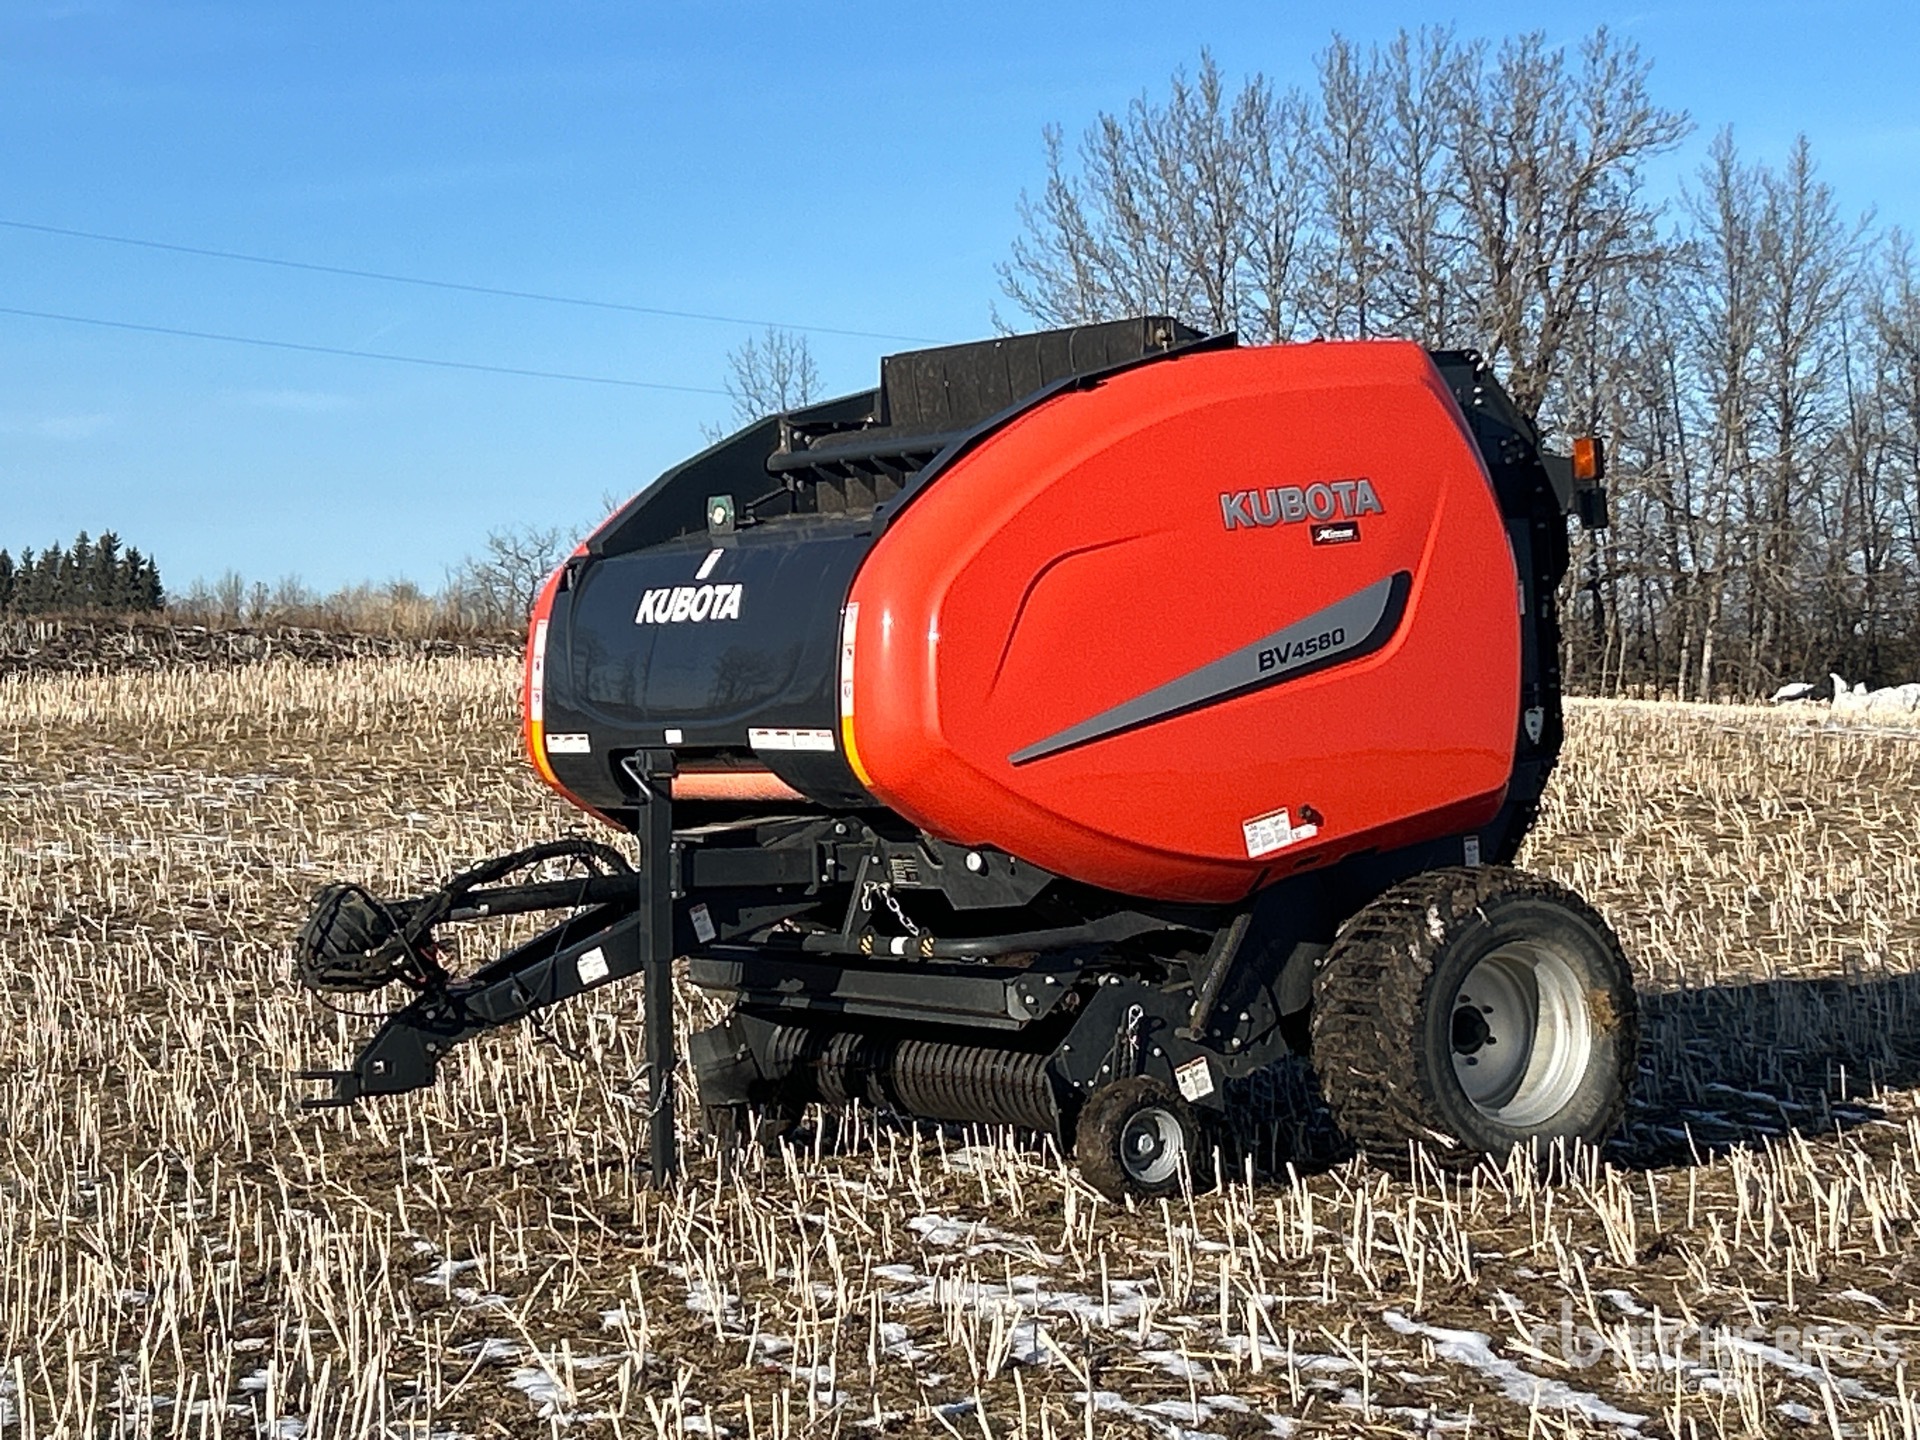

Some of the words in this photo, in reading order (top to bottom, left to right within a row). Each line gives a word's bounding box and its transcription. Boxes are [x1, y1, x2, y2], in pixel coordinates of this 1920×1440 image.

[1220, 478, 1384, 530] KUBOTA
[635, 584, 742, 623] KUBOTA
[1258, 627, 1345, 672] BV4580
